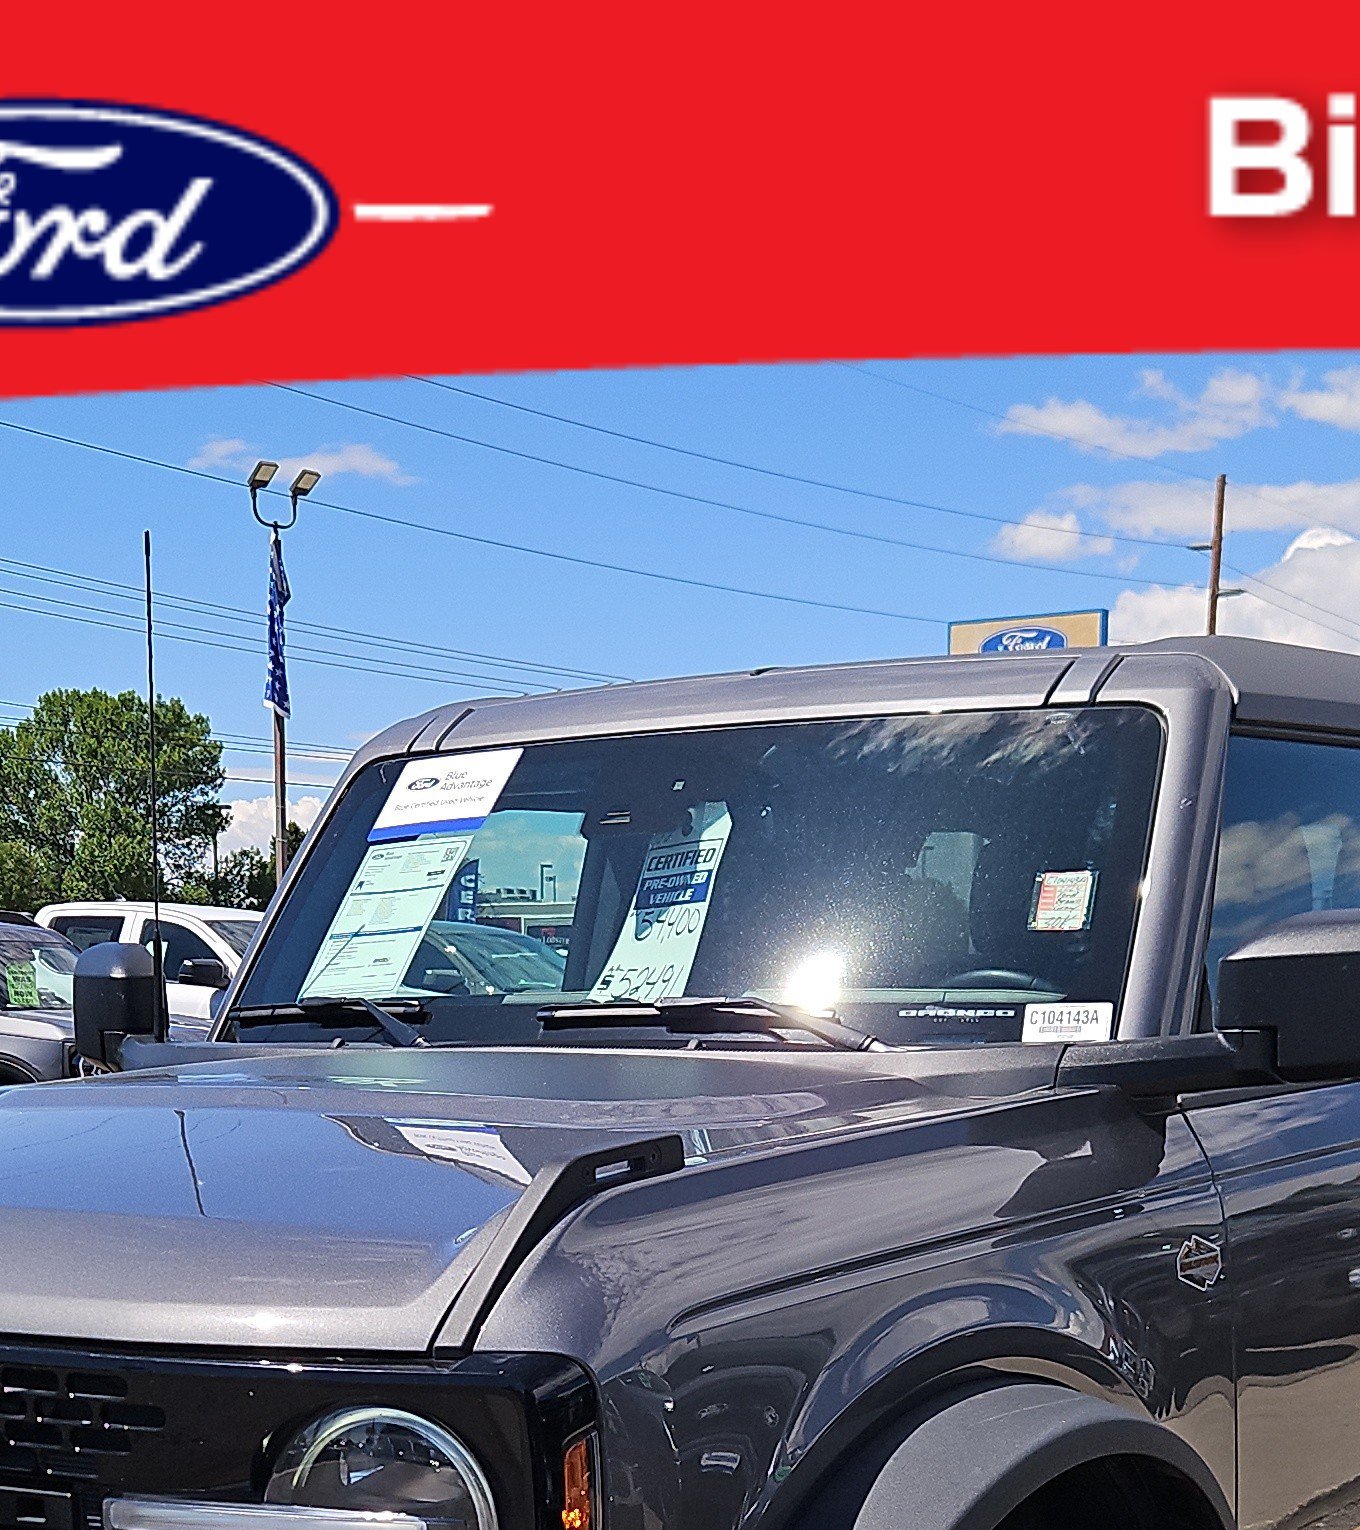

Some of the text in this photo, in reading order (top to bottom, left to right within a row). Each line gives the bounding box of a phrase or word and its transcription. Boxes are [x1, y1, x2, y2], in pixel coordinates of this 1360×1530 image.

[997, 630, 1051, 652] Ford
[439, 778, 493, 792] Advantage
[646, 847, 717, 873] CERTIFIED
[643, 871, 709, 892] PRE-OWNED
[649, 888, 695, 905] VEHICLE
[1030, 1009, 1099, 1025] C104143A
